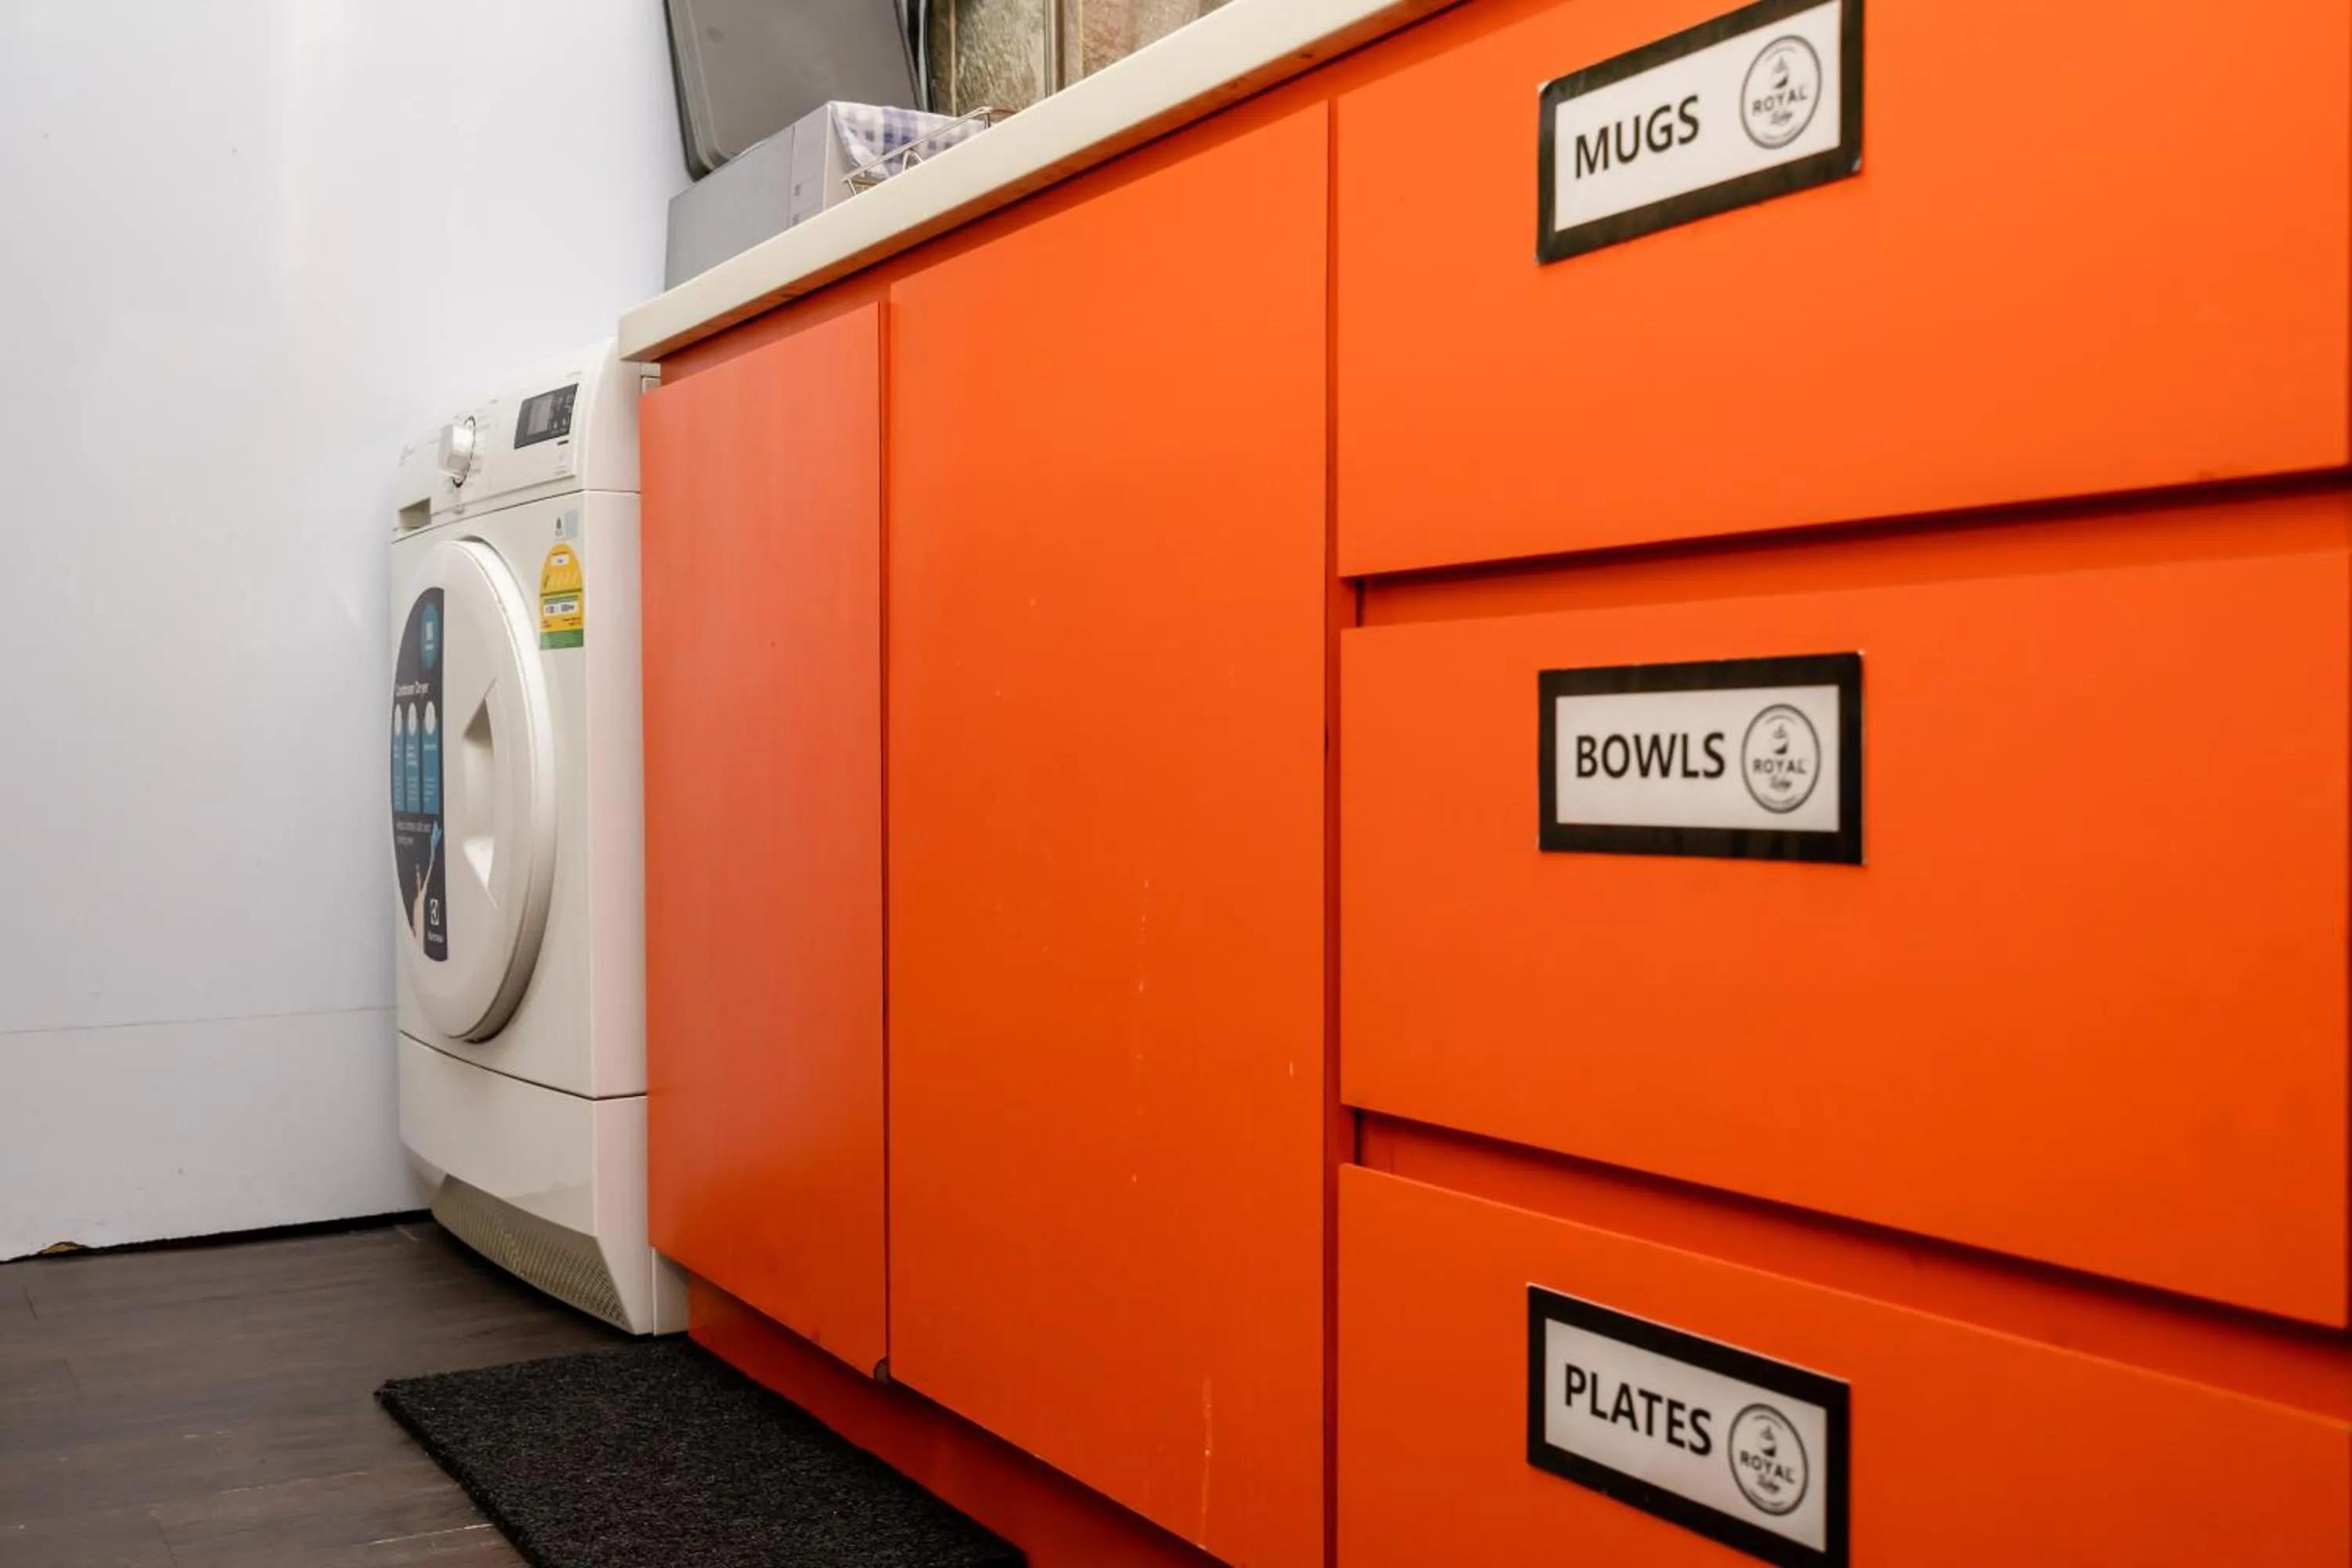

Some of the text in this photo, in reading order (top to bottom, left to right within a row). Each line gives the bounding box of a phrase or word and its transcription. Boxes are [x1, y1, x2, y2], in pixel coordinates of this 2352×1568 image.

[1752, 85, 1808, 116] ROYAL
[1575, 94, 1700, 180] MUGS
[1576, 731, 1726, 779] BOWLS
[1752, 757, 1806, 775] ROYAL
[1564, 1363, 1713, 1457] PLATES
[1740, 1450, 1795, 1486] ROYAL
